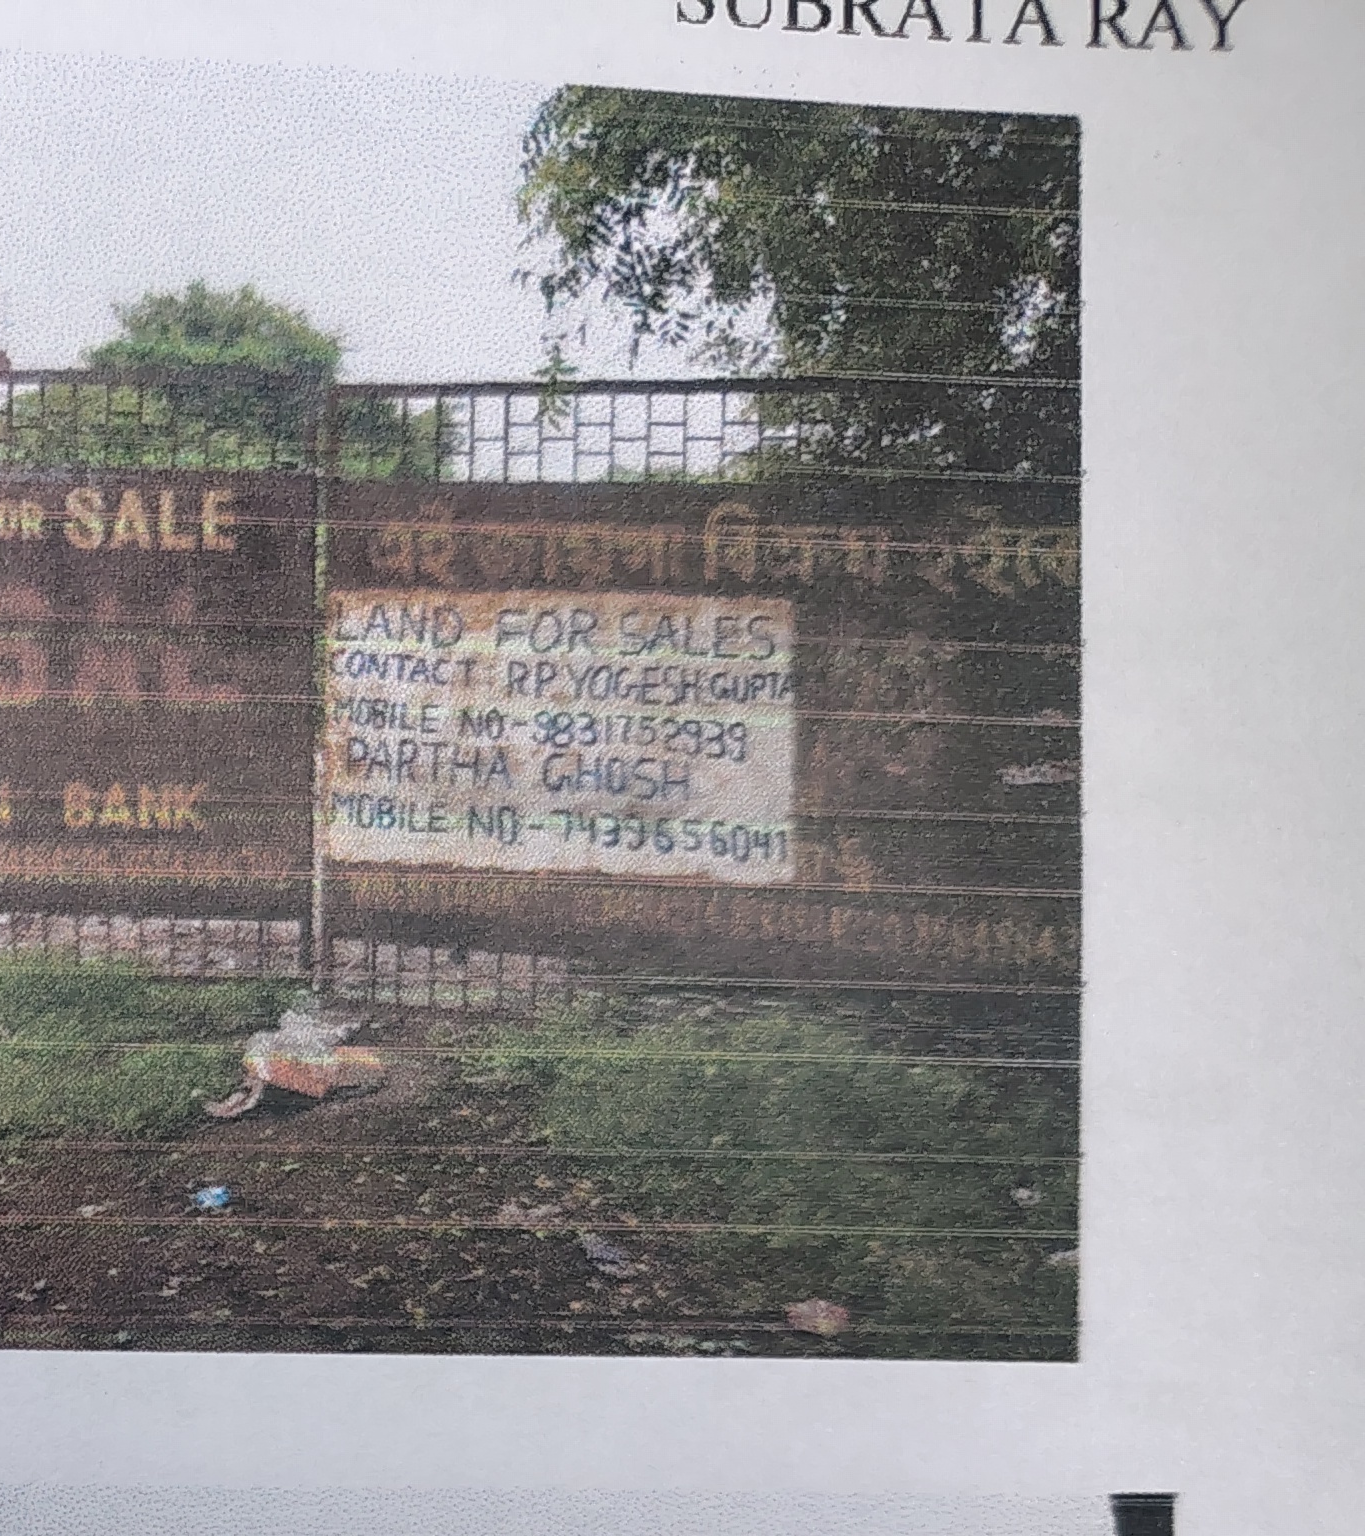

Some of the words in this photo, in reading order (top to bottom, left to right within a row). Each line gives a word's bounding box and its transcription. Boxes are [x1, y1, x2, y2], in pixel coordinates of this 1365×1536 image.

[1085, 0, 1248, 51] RAY
[64, 487, 237, 553] SALE
[333, 602, 464, 649] LAND
[495, 608, 599, 656] FOR
[618, 610, 777, 661] SALES
[330, 649, 478, 688] CONTACT
[567, 664, 704, 706] YOGESH
[710, 670, 798, 706] GUPTA
[334, 697, 440, 736] MOBILE
[346, 737, 516, 789] PARTHA
[540, 752, 693, 802] GHOSH
[64, 779, 209, 830] BANK
[331, 789, 449, 834] MOBILE
